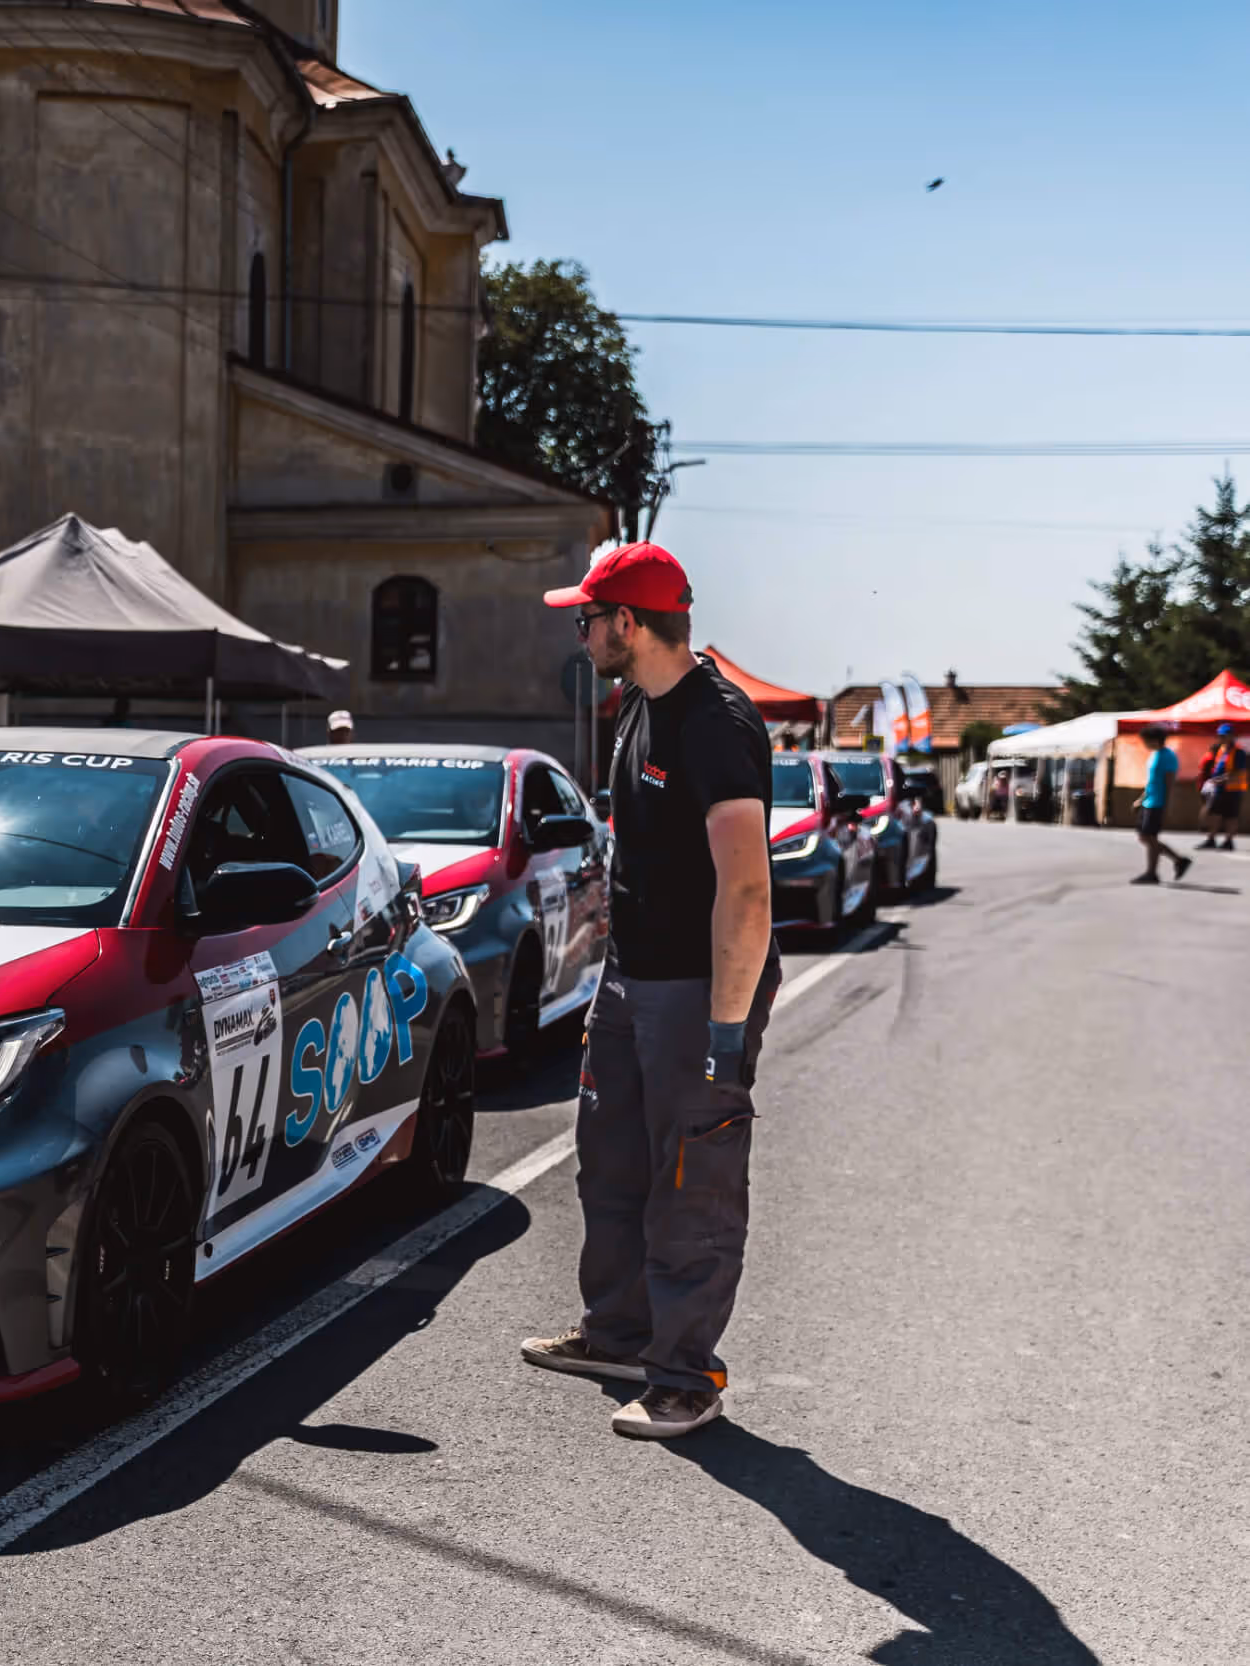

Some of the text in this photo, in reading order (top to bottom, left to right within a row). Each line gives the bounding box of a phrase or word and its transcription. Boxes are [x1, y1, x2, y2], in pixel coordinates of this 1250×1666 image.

[61, 755, 134, 769] CUP
[385, 758, 439, 768] YARIS
[441, 759, 485, 770] CUP
[213, 1008, 256, 1040] DYNAMAX
[284, 951, 428, 1148] SOOP
[217, 1055, 270, 1196] 64
